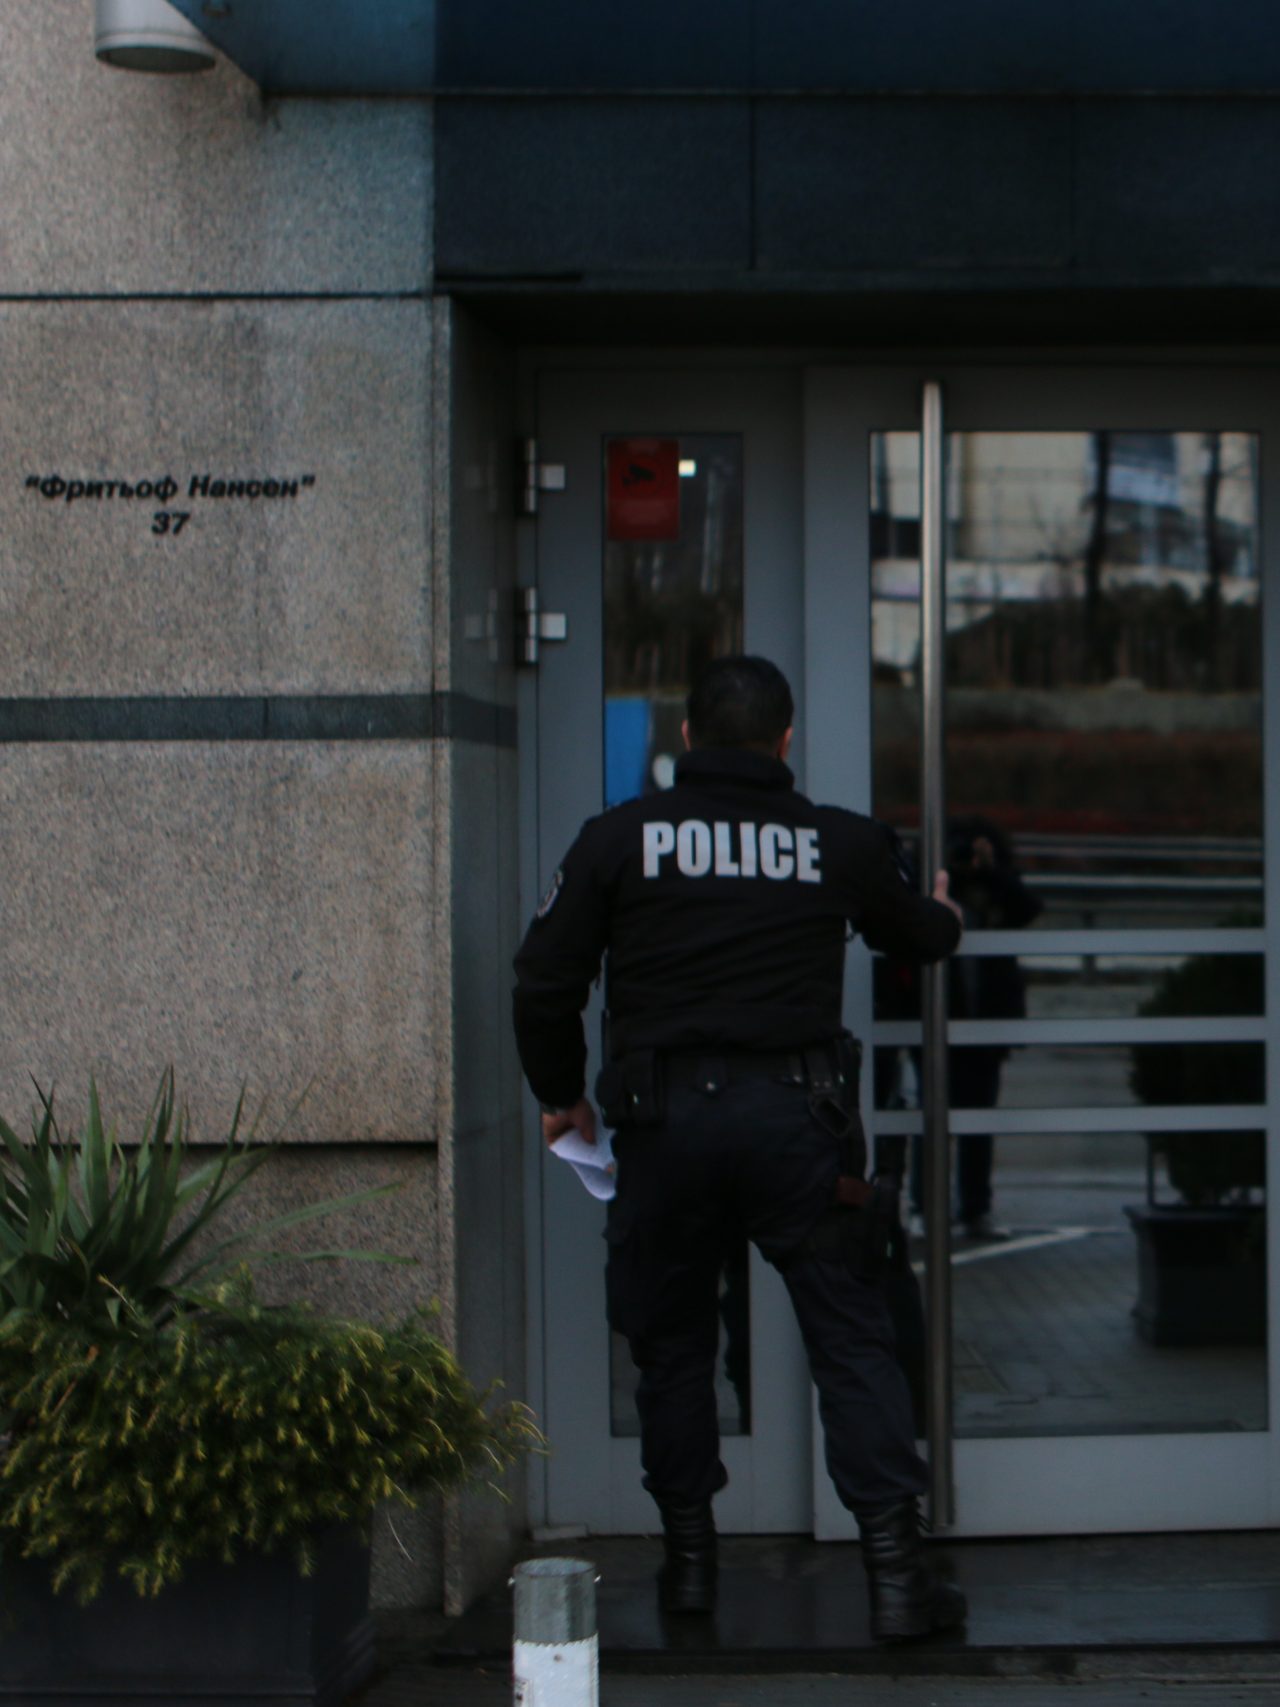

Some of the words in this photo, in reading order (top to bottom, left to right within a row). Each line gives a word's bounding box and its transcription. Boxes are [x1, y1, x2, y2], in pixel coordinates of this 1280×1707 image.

[25, 474, 178, 503] "Фритьоф
[188, 474, 315, 499] Нансен"
[151, 511, 190, 535] 37
[643, 819, 821, 884] POLICE
